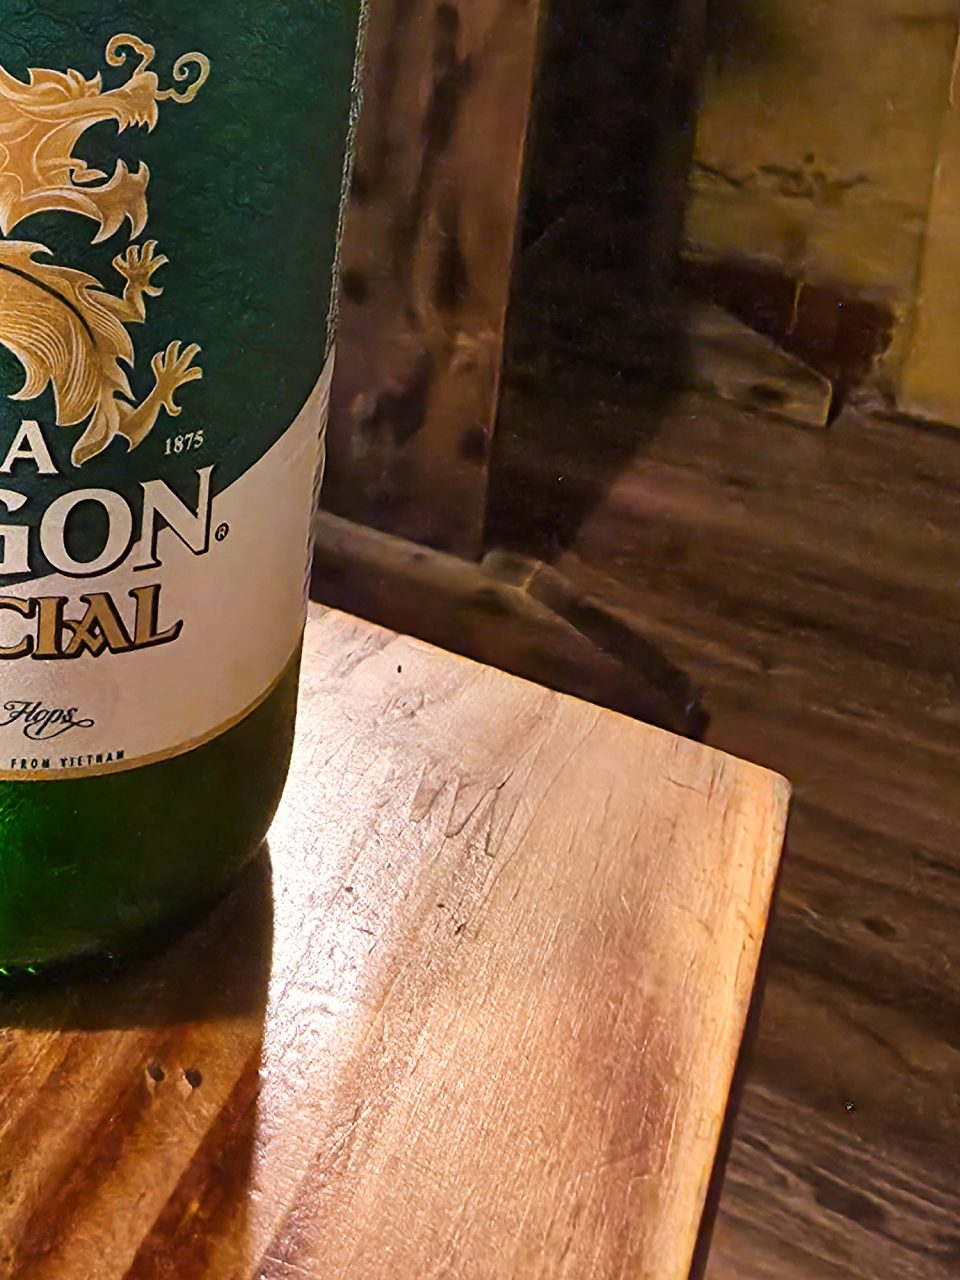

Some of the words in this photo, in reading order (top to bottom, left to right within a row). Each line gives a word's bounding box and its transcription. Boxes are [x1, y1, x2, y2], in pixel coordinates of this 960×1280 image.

[163, 429, 204, 455] 1875
[10, 757, 50, 770] FROM
[60, 750, 126, 768] VIETNAM
